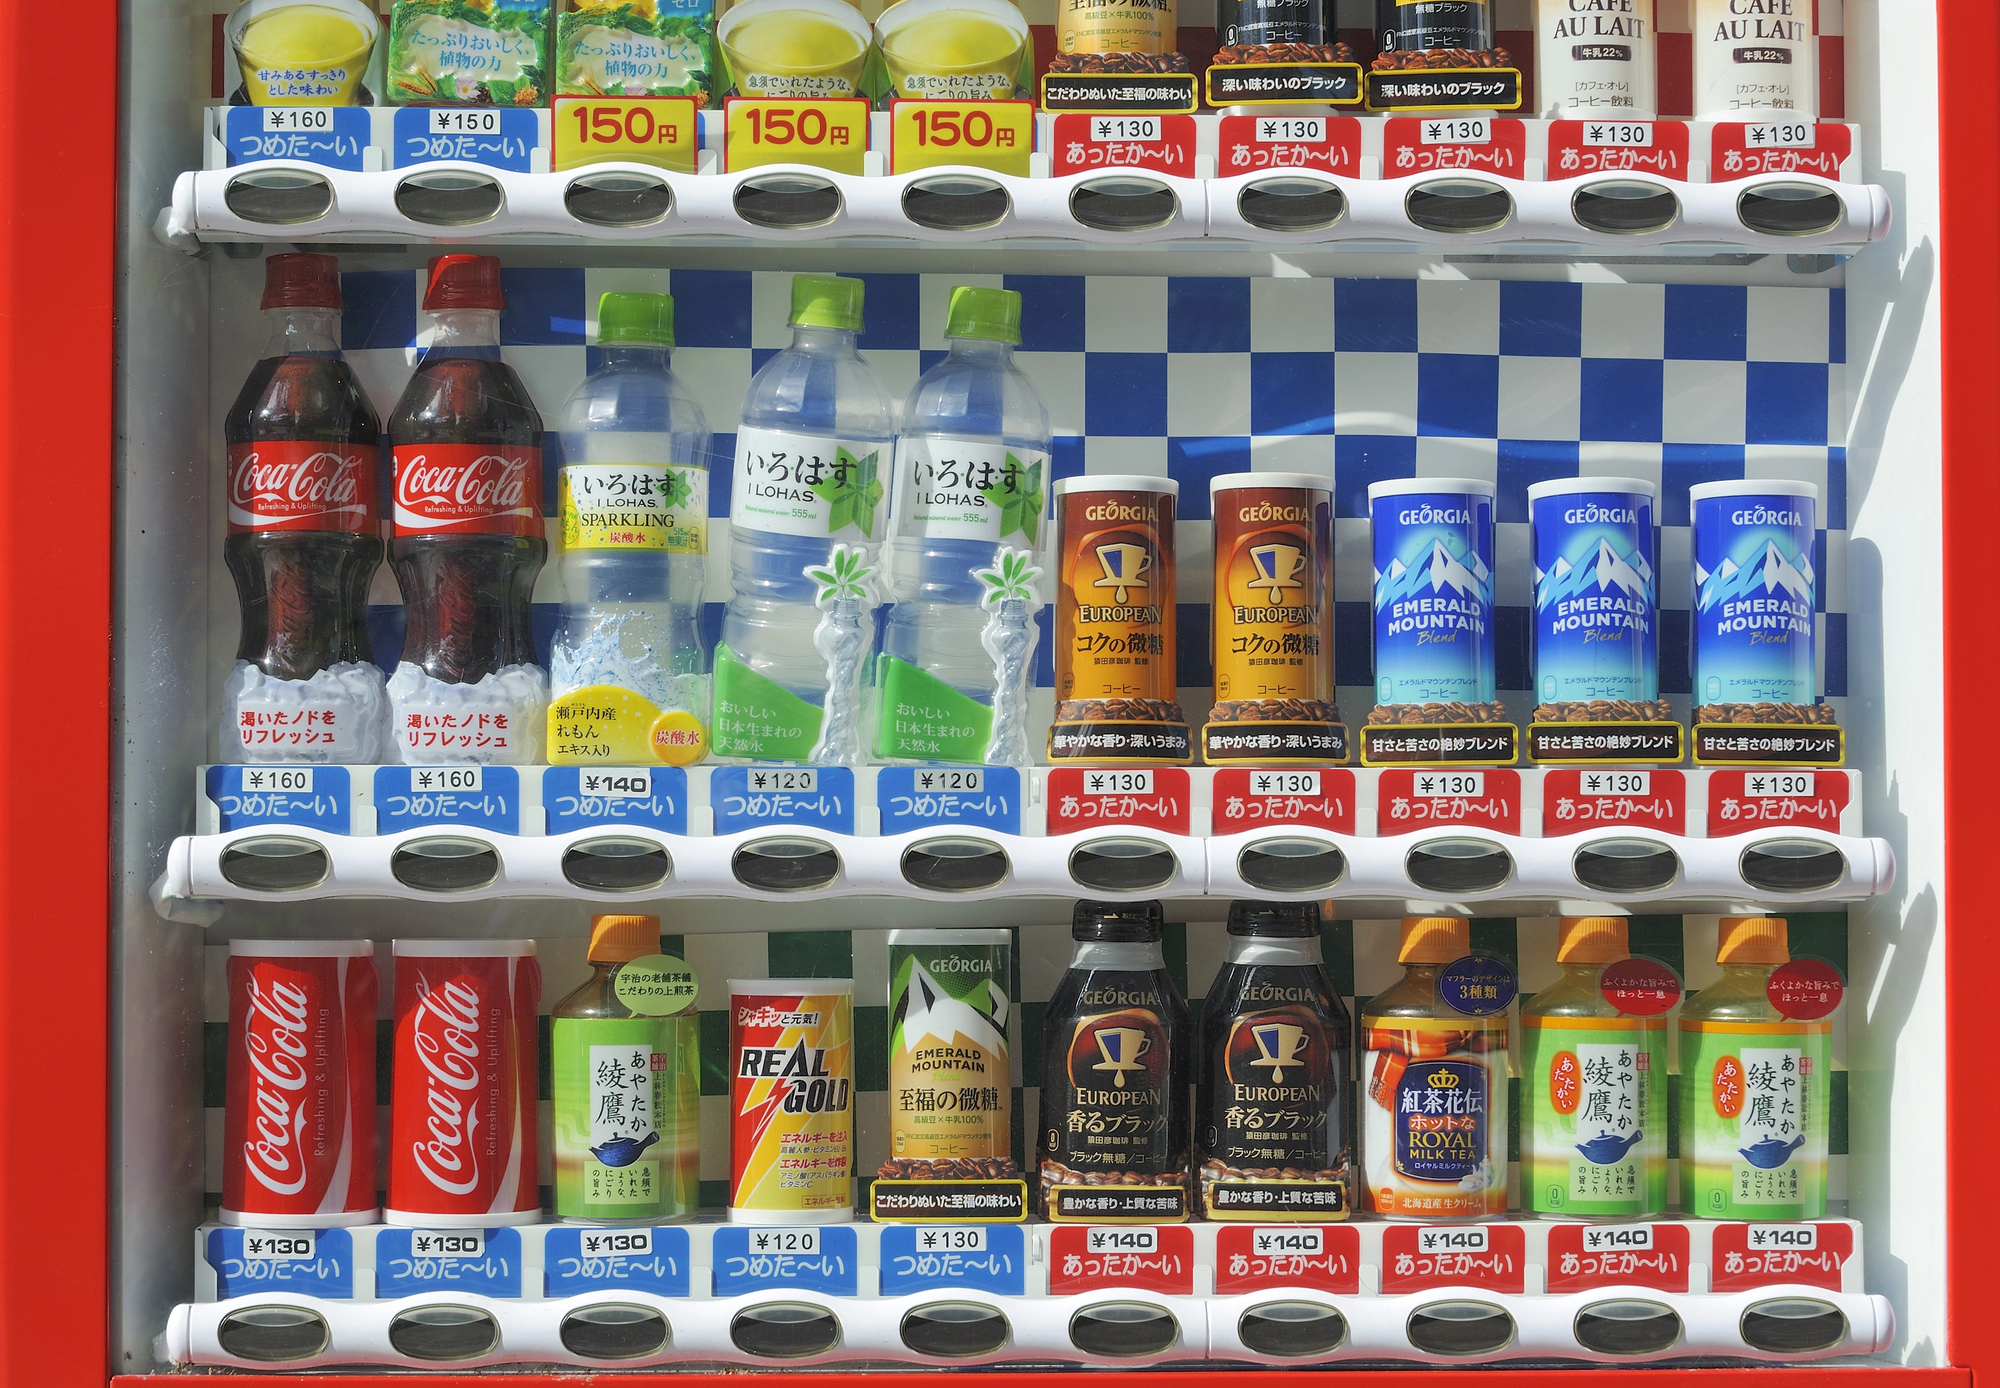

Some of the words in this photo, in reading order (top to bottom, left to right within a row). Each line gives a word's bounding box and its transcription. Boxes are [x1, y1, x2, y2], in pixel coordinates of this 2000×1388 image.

[1266, 30, 1303, 41] コーヒー
[1553, 16, 1586, 40] AU
[1593, 17, 1645, 39] LAIT
[1714, 19, 1747, 42] AU
[1755, 19, 1805, 42] LAIT
[1101, 38, 1138, 48] コーヒー
[1425, 36, 1461, 46] コーヒー
[1582, 47, 1623, 58] 牛乳22%
[1743, 50, 1784, 61] 牛乳22%
[439, 51, 502, 72] 植物の力
[605, 60, 668, 79] 植物の力
[258, 68, 346, 83] 甘みあるすっきり
[1222, 76, 1347, 92] 深い味わいのブラック
[268, 83, 338, 96] とした味わい
[1047, 87, 1192, 101] こだわりぬいた至福の味わい
[1381, 81, 1505, 98] 深い味わいのブラック
[1569, 95, 1633, 108] コーヒー飲料
[270, 110, 328, 129] ¥160
[438, 112, 494, 130] ¥150
[573, 106, 677, 144] 150円
[746, 108, 849, 145] 150円
[912, 110, 1015, 147] 150円
[1098, 120, 1154, 138] ¥130
[1263, 120, 1318, 138] ¥130
[1428, 121, 1483, 140] ¥130
[1590, 126, 1645, 143] ¥130
[1752, 125, 1807, 144] ¥130
[234, 452, 362, 504] Coca-Cola
[400, 454, 529, 506] Coca-Cola
[258, 502, 289, 512] Refreshing
[290, 503, 297, 511] &
[925, 493, 985, 507] LOHAS
[424, 505, 456, 515] Refreshing
[457, 506, 463, 514] &
[1086, 502, 1155, 521] GEORGIA
[1239, 502, 1311, 522] GEORGIA
[1400, 505, 1471, 524] GEORGIA
[1564, 504, 1636, 524] GEORGIA
[1732, 506, 1801, 526] GEORGIA
[581, 513, 675, 528] SPARKLING
[609, 532, 646, 544] 炭酸水
[1079, 605, 1162, 623] EUROPEAN
[1233, 606, 1317, 624] EUROPEAN
[1393, 599, 1480, 618] EMERALD
[1558, 597, 1645, 617] EMERALD
[1723, 599, 1808, 618] EMERALD
[1388, 615, 1484, 636] MOUNTAIN
[1553, 613, 1649, 635] MOUNTAIN
[1718, 615, 1811, 637] MOUNTAIN
[1077, 632, 1164, 656] コクの微糖
[1232, 632, 1319, 656] コクの微糖
[1103, 684, 1140, 694] コーヒー
[1258, 685, 1295, 694] コーヒー
[1420, 689, 1458, 699] コーヒー
[1586, 687, 1624, 697] コーヒー
[1752, 689, 1789, 699] コーヒー
[556, 706, 616, 722] 瀬戸内産
[719, 700, 777, 720] おいしい
[896, 702, 950, 719] おいしい
[241, 711, 336, 727] 渇いたノドを
[407, 713, 508, 729] 渇いたノドを
[243, 729, 336, 744] リフレッシュ
[557, 724, 599, 739] れもん
[719, 721, 802, 739] 日本生まれの
[895, 719, 976, 738] 日本生まれの
[408, 731, 508, 747] リフレッシュ
[656, 730, 700, 746] 炭酸水
[719, 737, 764, 753] 天然水
[896, 737, 940, 753] 天然水
[1372, 738, 1508, 753] 甘さと苦さの絶妙ブレンド
[1537, 735, 1673, 750] 甘さと苦さの絶妙ブレンド
[1703, 737, 1835, 752] 甘さと苦さの絶妙ブレンド
[558, 744, 611, 757] エキス入り
[249, 772, 306, 789] ¥160
[419, 771, 475, 788] ¥160
[585, 776, 646, 793] ¥140
[754, 772, 811, 789] ¥120
[921, 773, 977, 789] ¥120
[1091, 774, 1146, 790] ¥130
[1257, 775, 1313, 792] ¥130
[1420, 776, 1476, 794] ¥130
[1587, 775, 1642, 792] ¥130
[1752, 777, 1806, 793] ¥130
[930, 956, 993, 973] GEORGIA
[1083, 987, 1156, 1006] GEORGIA
[1239, 983, 1315, 1002] GEORGIA
[1460, 984, 1497, 1000] 3種類
[315, 1008, 330, 1067] Uplifting
[487, 1008, 500, 1067] Uplifting
[741, 1038, 828, 1076] REAL
[916, 1047, 982, 1061] EMERALD
[912, 1059, 984, 1073] MOUNTAIN
[244, 968, 308, 1195] Coca-Cola
[413, 968, 480, 1195] Coca-Cola
[595, 1057, 629, 1125] 綾鷹
[630, 1050, 647, 1133] あやたか
[784, 1077, 849, 1113] GOLD
[899, 1087, 999, 1112] 至福の微糖
[1076, 1087, 1161, 1106] EUROPEAN
[1234, 1083, 1320, 1102] EUROPEAN
[1400, 1087, 1483, 1115] 紅茶花伝
[313, 1089, 329, 1156] Refreshing
[486, 1088, 500, 1156] Refreshing
[1066, 1110, 1168, 1133] 香るブラック
[1224, 1105, 1328, 1129] 香るブラック
[1409, 1115, 1476, 1131] ホットな
[929, 1144, 968, 1153] コーヒー
[1408, 1132, 1476, 1148] ROYAL
[1410, 1149, 1444, 1159] MILK
[1450, 1149, 1476, 1159] TEA
[876, 1194, 1022, 1209] こだわりぬいた至福の味わい
[416, 1236, 478, 1252] ¥130
[586, 1234, 648, 1251] ¥130
[755, 1233, 813, 1250] ¥120
[923, 1231, 979, 1248] ¥130
[1092, 1233, 1153, 1248] ¥140
[1258, 1234, 1318, 1250] ¥140
[1423, 1232, 1484, 1248] ¥140
[1588, 1229, 1648, 1247] ¥140
[1753, 1229, 1812, 1245] ¥140
[248, 1238, 311, 1254] ¥130
